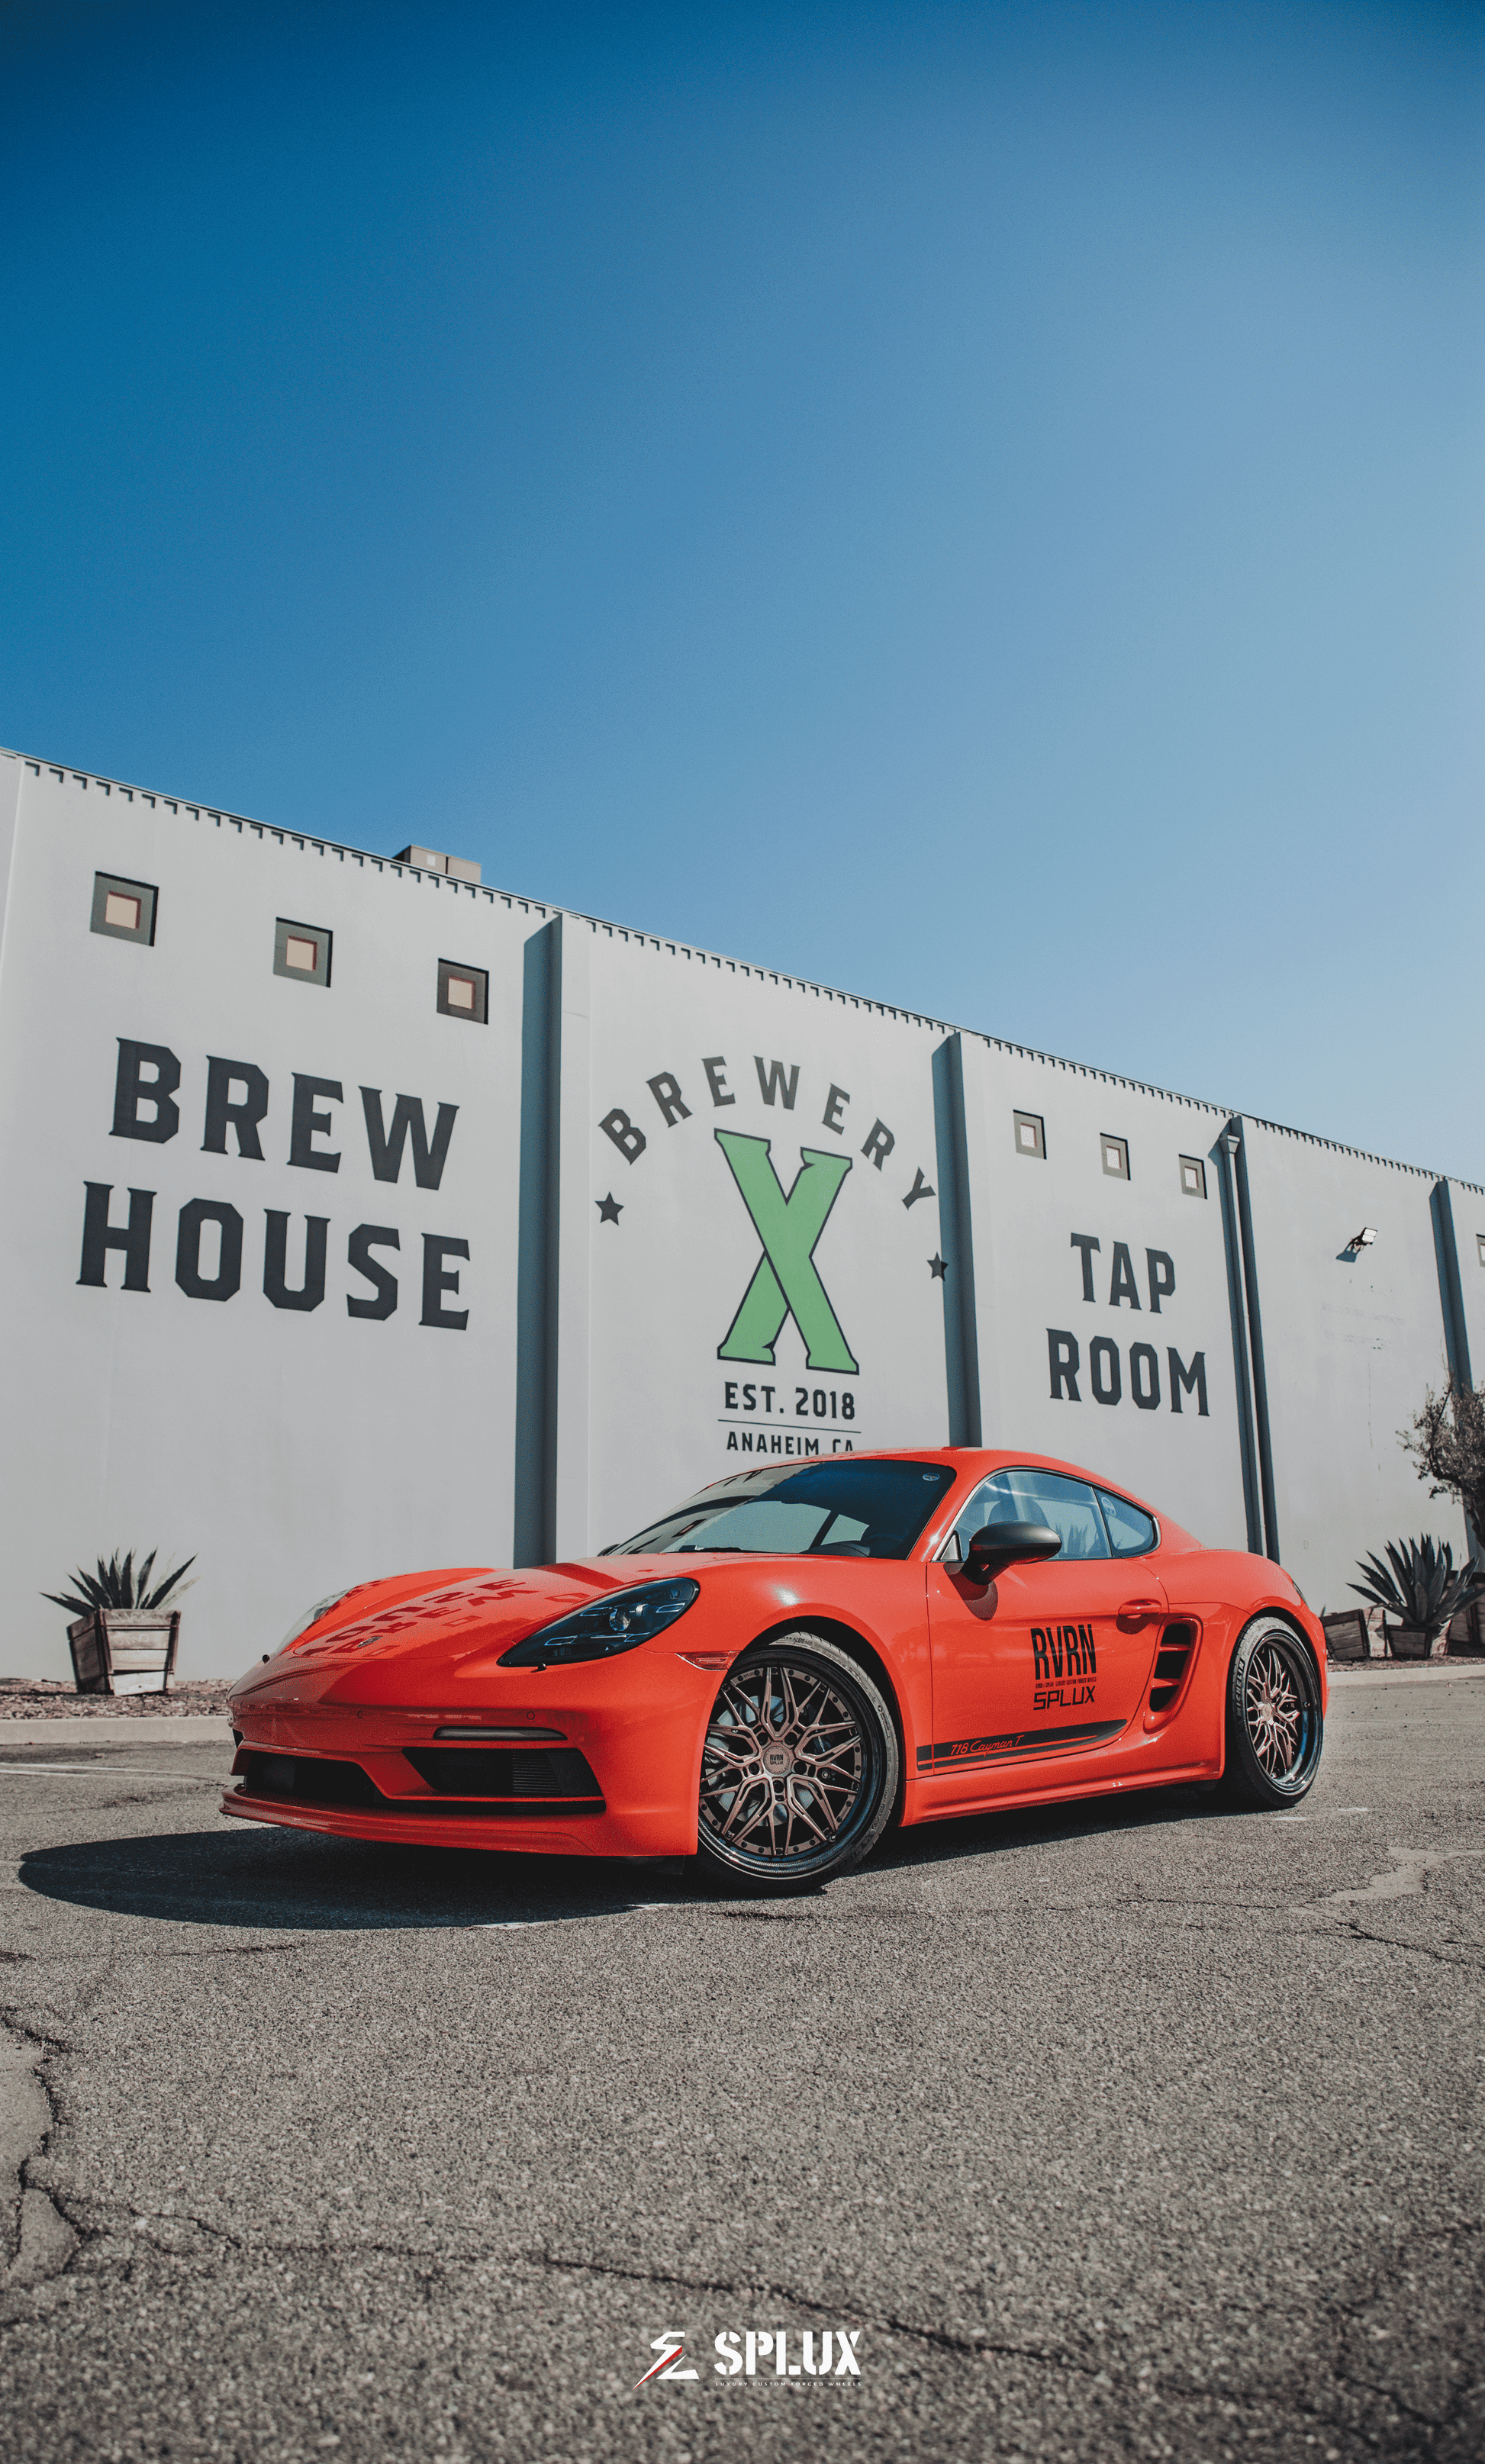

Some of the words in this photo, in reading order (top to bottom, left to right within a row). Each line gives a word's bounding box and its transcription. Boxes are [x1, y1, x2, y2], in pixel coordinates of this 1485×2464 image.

[109, 1038, 459, 1190] BREW
[598, 1056, 936, 1210] BREWERY
[76, 1181, 471, 1331] HOUSE
[714, 1127, 860, 1376] X
[1071, 1232, 1176, 1314] TAP
[725, 1381, 784, 1414] EST.
[795, 1387, 855, 1420] 2018
[1046, 1329, 1210, 1417] ROOM
[1031, 1624, 1097, 1680] RVRN
[1033, 1685, 1096, 1711] SPLUX
[950, 1742, 970, 1756] 718
[970, 1740, 1013, 1757] Cayman
[1015, 1734, 1025, 1746] T
